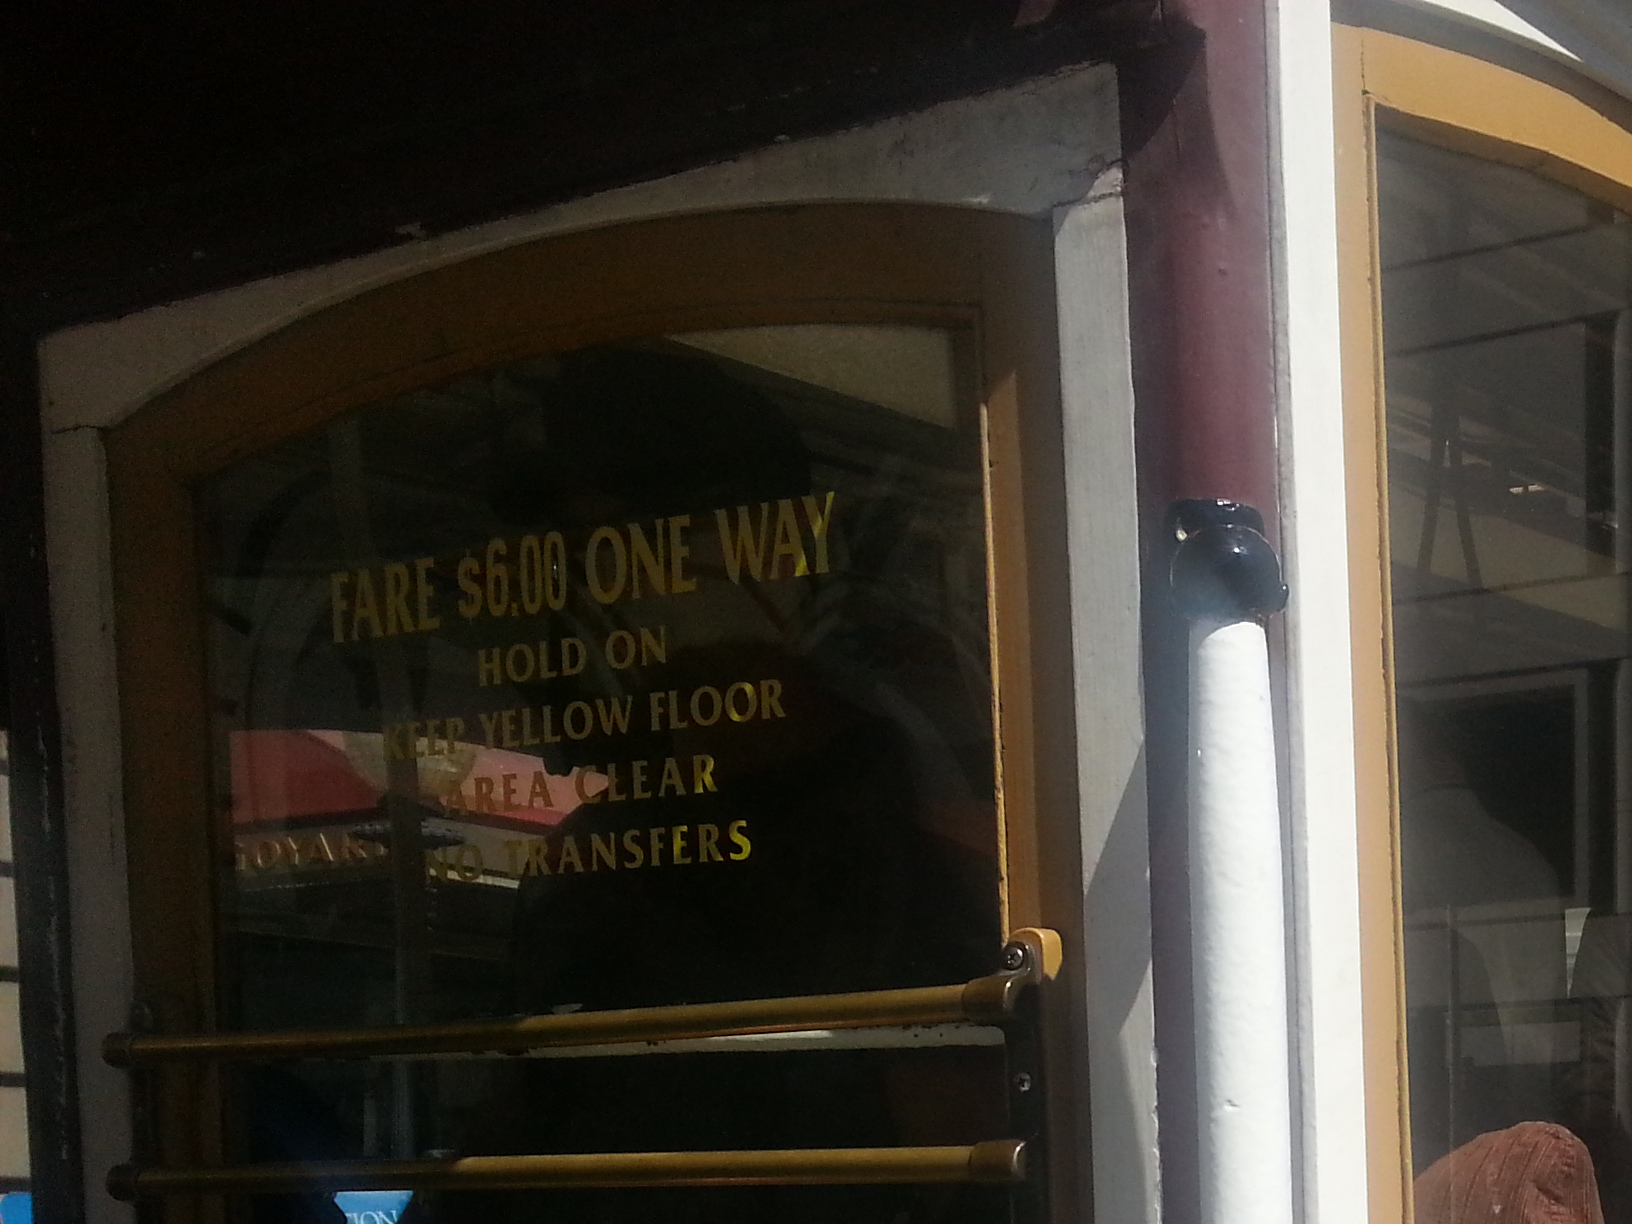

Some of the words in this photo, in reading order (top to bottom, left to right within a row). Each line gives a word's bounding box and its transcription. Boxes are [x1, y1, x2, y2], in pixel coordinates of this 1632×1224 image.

[330, 557, 441, 644] FARE
[457, 528, 568, 625] $6.00
[585, 514, 698, 605] ONE
[714, 491, 835, 585] WAY
[478, 637, 587, 687] HOLD
[605, 625, 667, 670] ON
[382, 716, 466, 761] KEEP
[479, 694, 633, 749] YELLOW
[649, 679, 787, 732] FLOOR
[444, 770, 554, 817] AREA
[575, 753, 718, 804] CLEAR
[424, 844, 483, 882] NO
[504, 819, 753, 877] TRANSFERS
